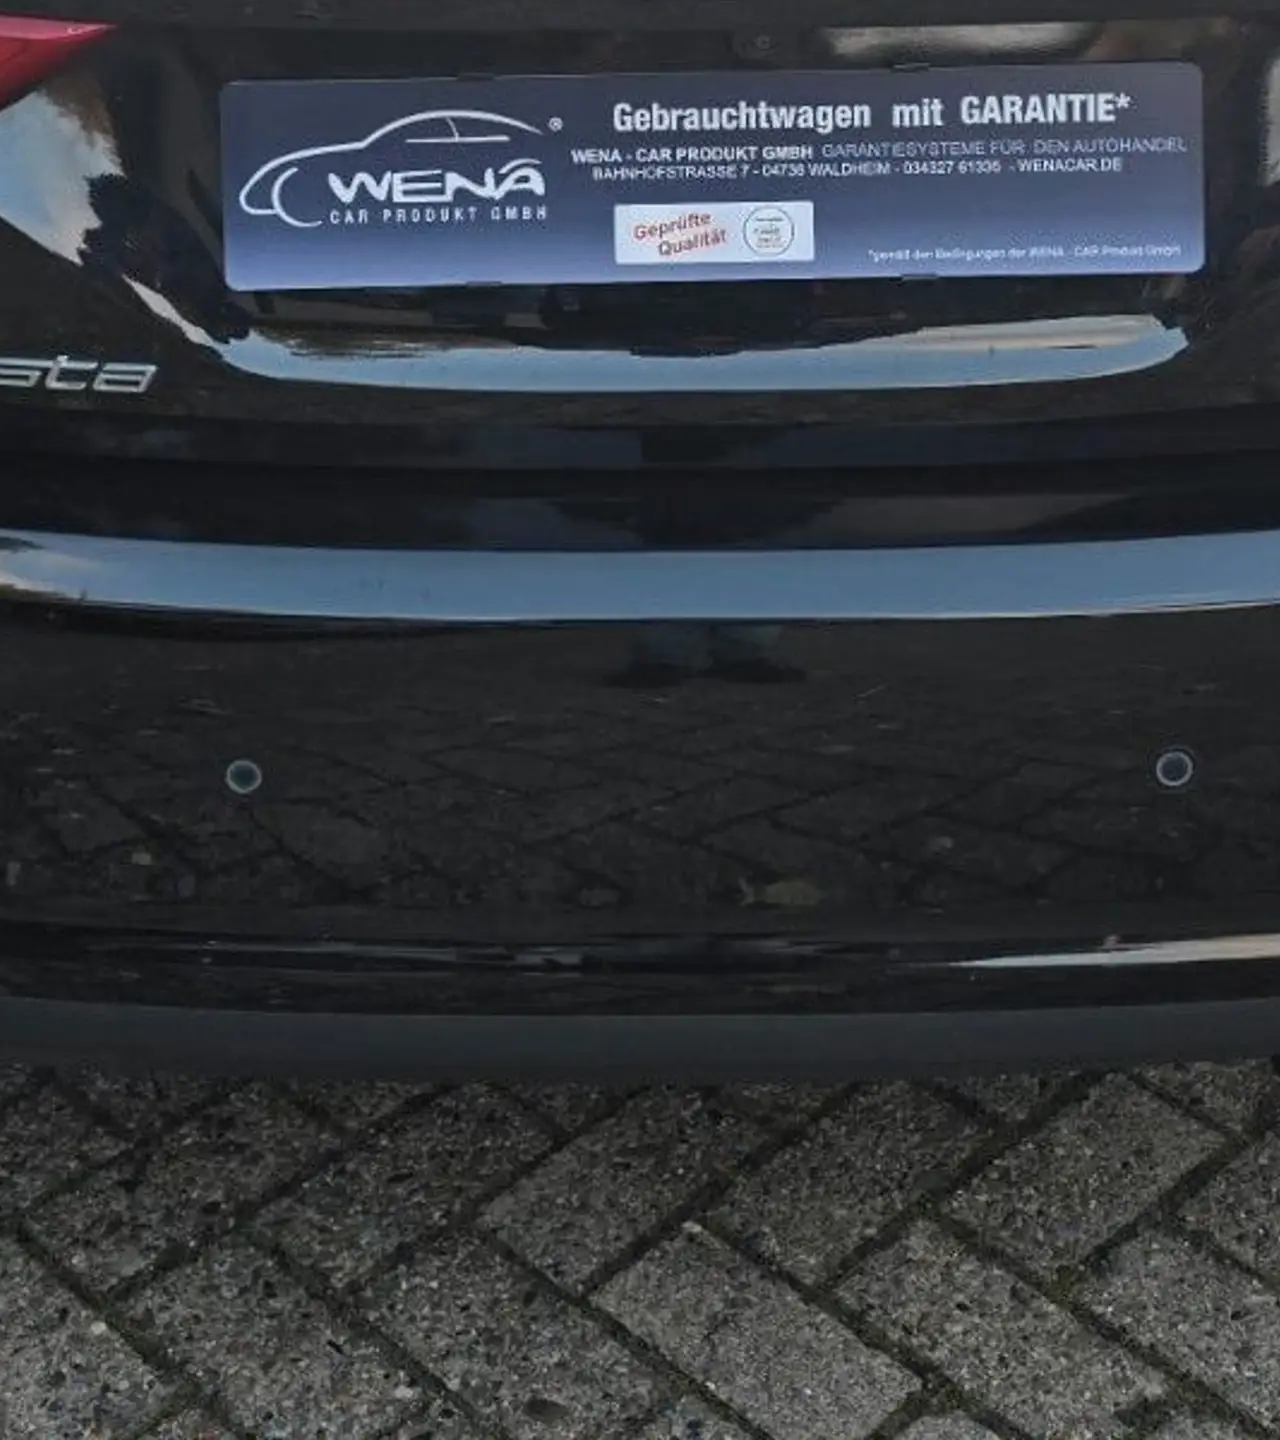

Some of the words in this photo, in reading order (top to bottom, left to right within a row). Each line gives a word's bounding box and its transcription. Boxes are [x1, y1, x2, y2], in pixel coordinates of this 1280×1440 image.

[613, 101, 871, 134] Gebrauchtwagen
[891, 98, 945, 128] mit
[571, 147, 622, 164] WENA
[635, 146, 672, 162] CAR
[675, 144, 758, 161] PRODUKT
[762, 143, 813, 160] GMBH
[1033, 138, 1070, 154] DEN
[1073, 137, 1189, 153] AUTOHANDEL
[326, 158, 546, 204] WENA
[592, 164, 737, 181] BAHNHOFSTRASSE
[329, 208, 369, 225] CAR
[381, 207, 477, 224] PRODUKT
[490, 206, 547, 221] GMBH
[633, 212, 711, 241] Geprüfte
[657, 228, 729, 257] Qualität
